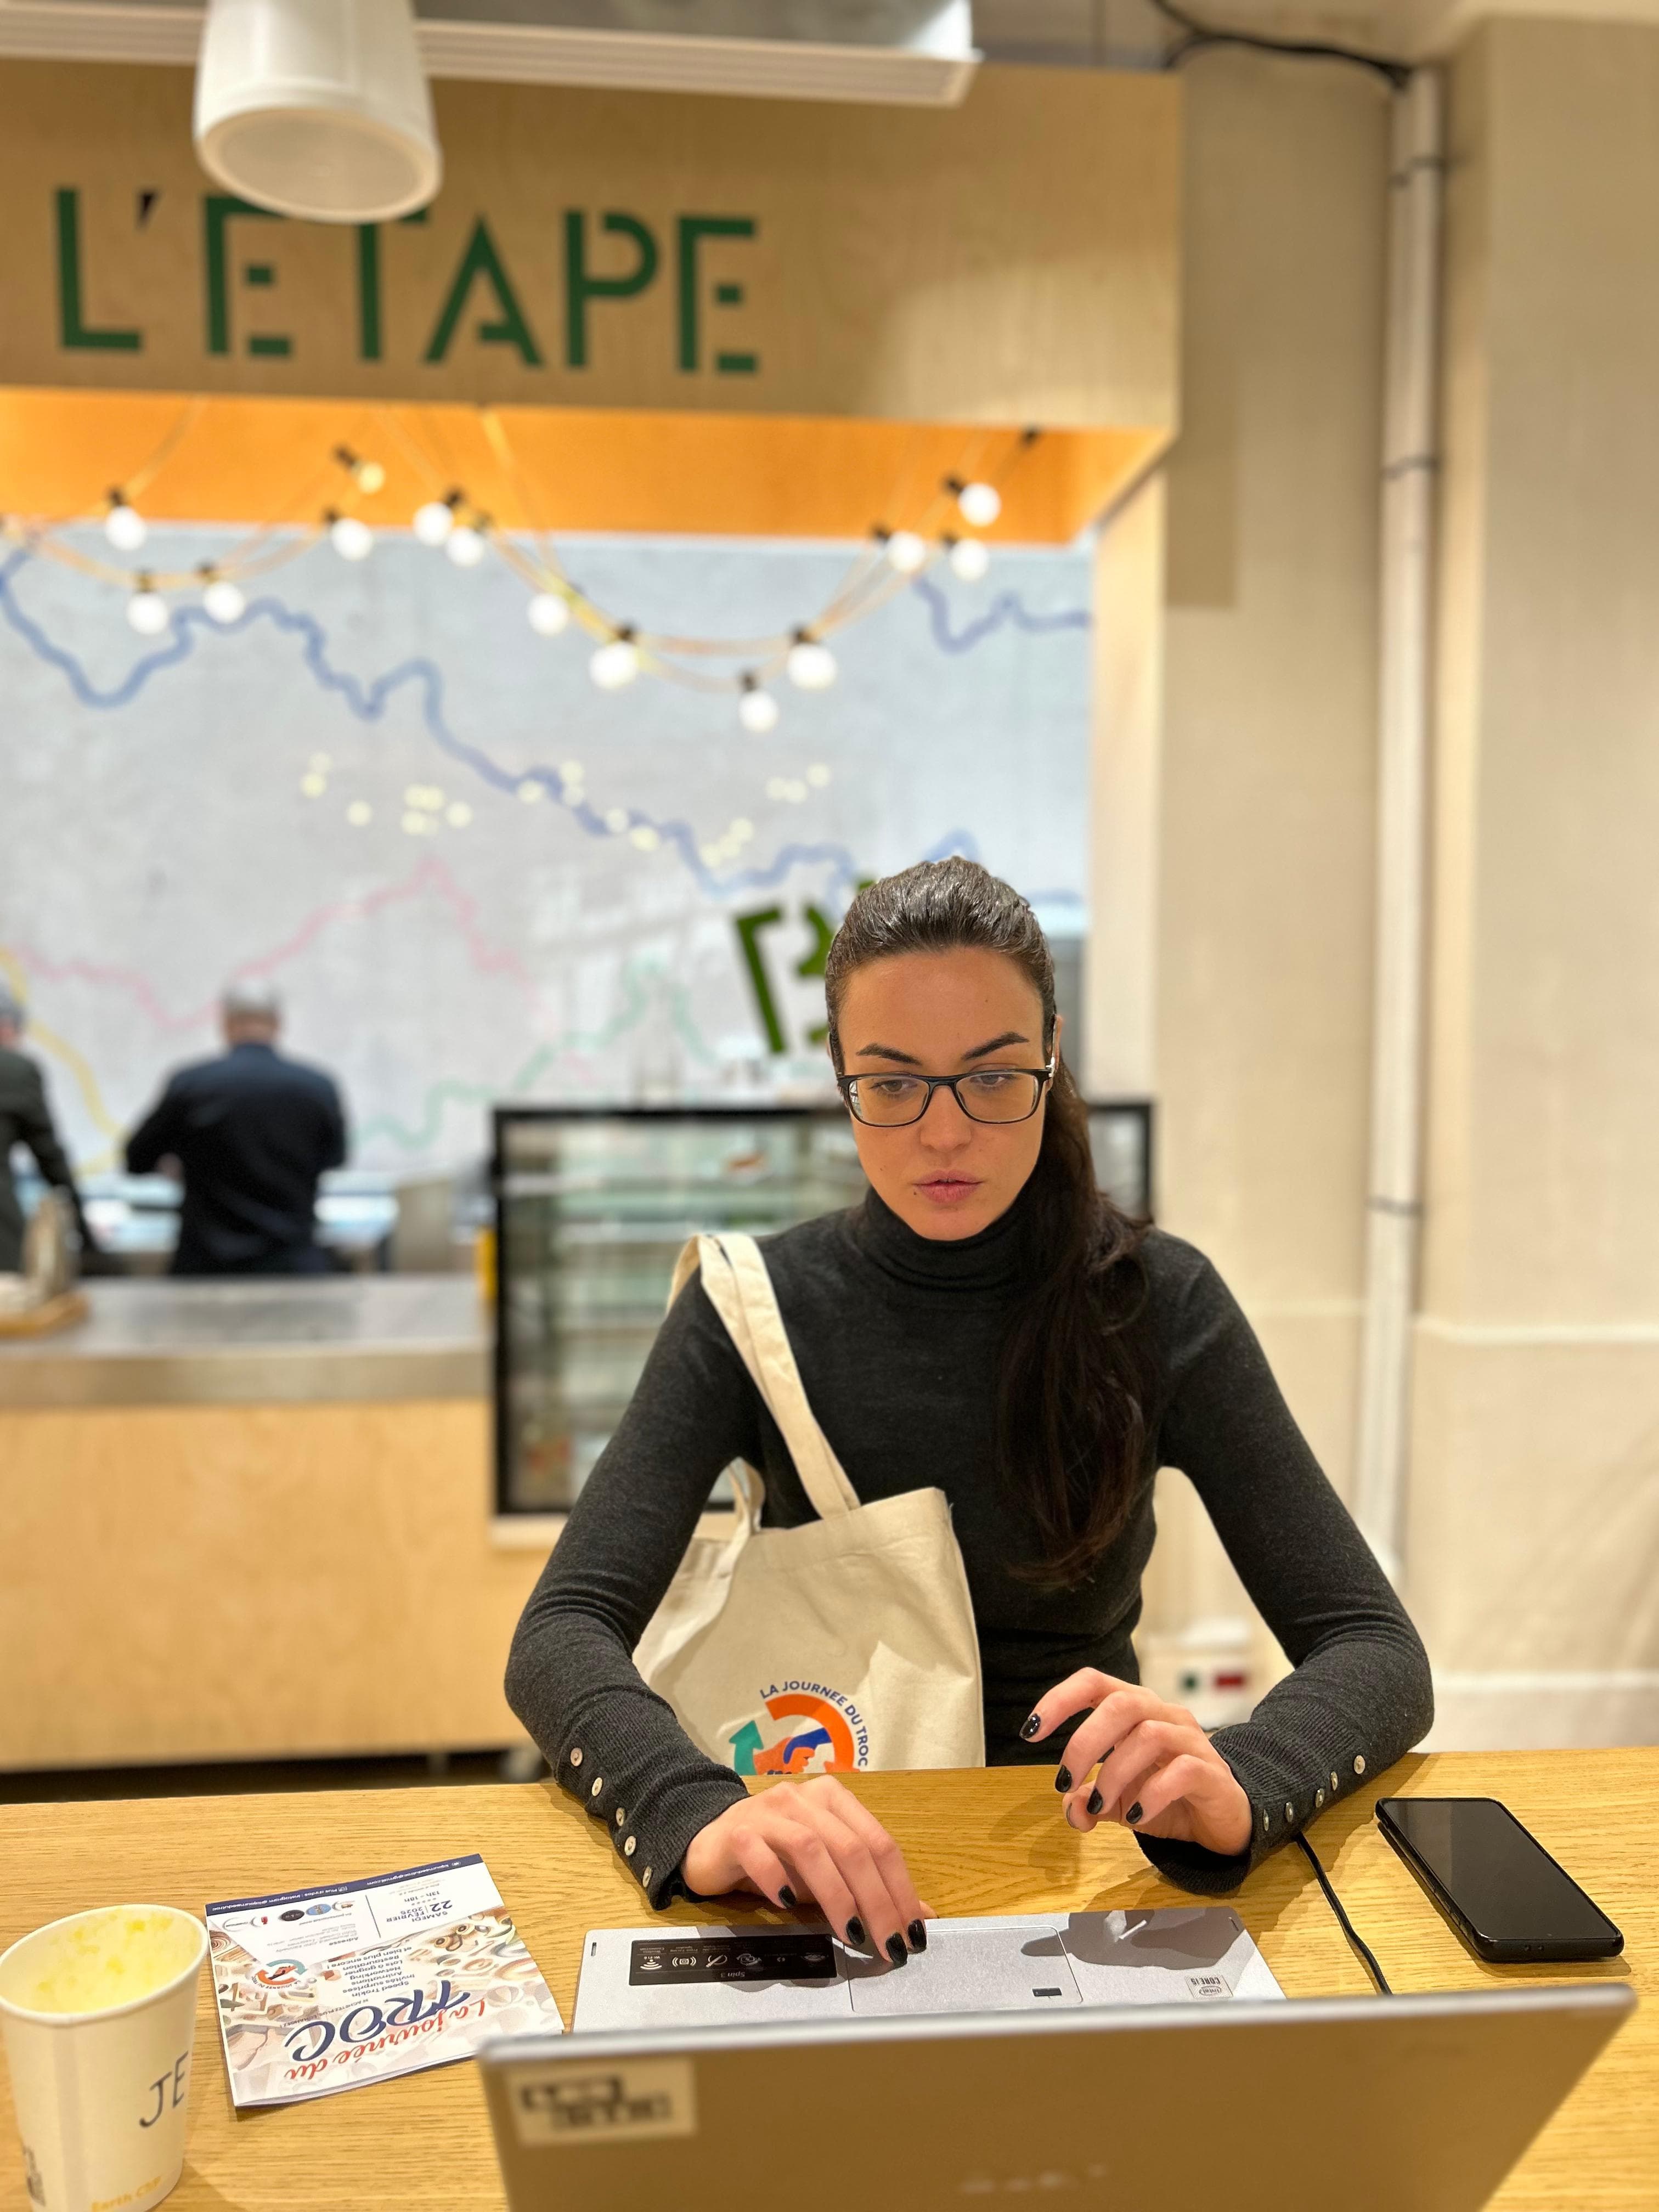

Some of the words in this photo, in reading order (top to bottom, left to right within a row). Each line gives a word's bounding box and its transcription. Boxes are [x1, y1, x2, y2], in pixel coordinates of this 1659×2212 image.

[760, 1684, 779, 1699] LA
[783, 1680, 848, 1706] JOURNEE
[844, 1704, 862, 1725] DU
[856, 1726, 868, 1767] TROC
[430, 1900, 452, 1912] 22
[411, 1911, 448, 1922] SAMEDI
[329, 1937, 358, 1945] Adresse
[364, 1952, 381, 1960] plus
[331, 1958, 362, 1967] encore
[343, 1955, 399, 1971] Restauration
[345, 1966, 376, 1976] gagner
[349, 1966, 400, 1980] Networking
[351, 1971, 402, 1985] Animations
[343, 1981, 383, 1993] surprises
[352, 1988, 380, 1997] Trokin
[382, 1981, 409, 1992] Speed
[449, 1999, 484, 2019] La
[284, 1980, 470, 2062] TROC
[332, 2010, 445, 2065] journée
[284, 2059, 328, 2080] du
